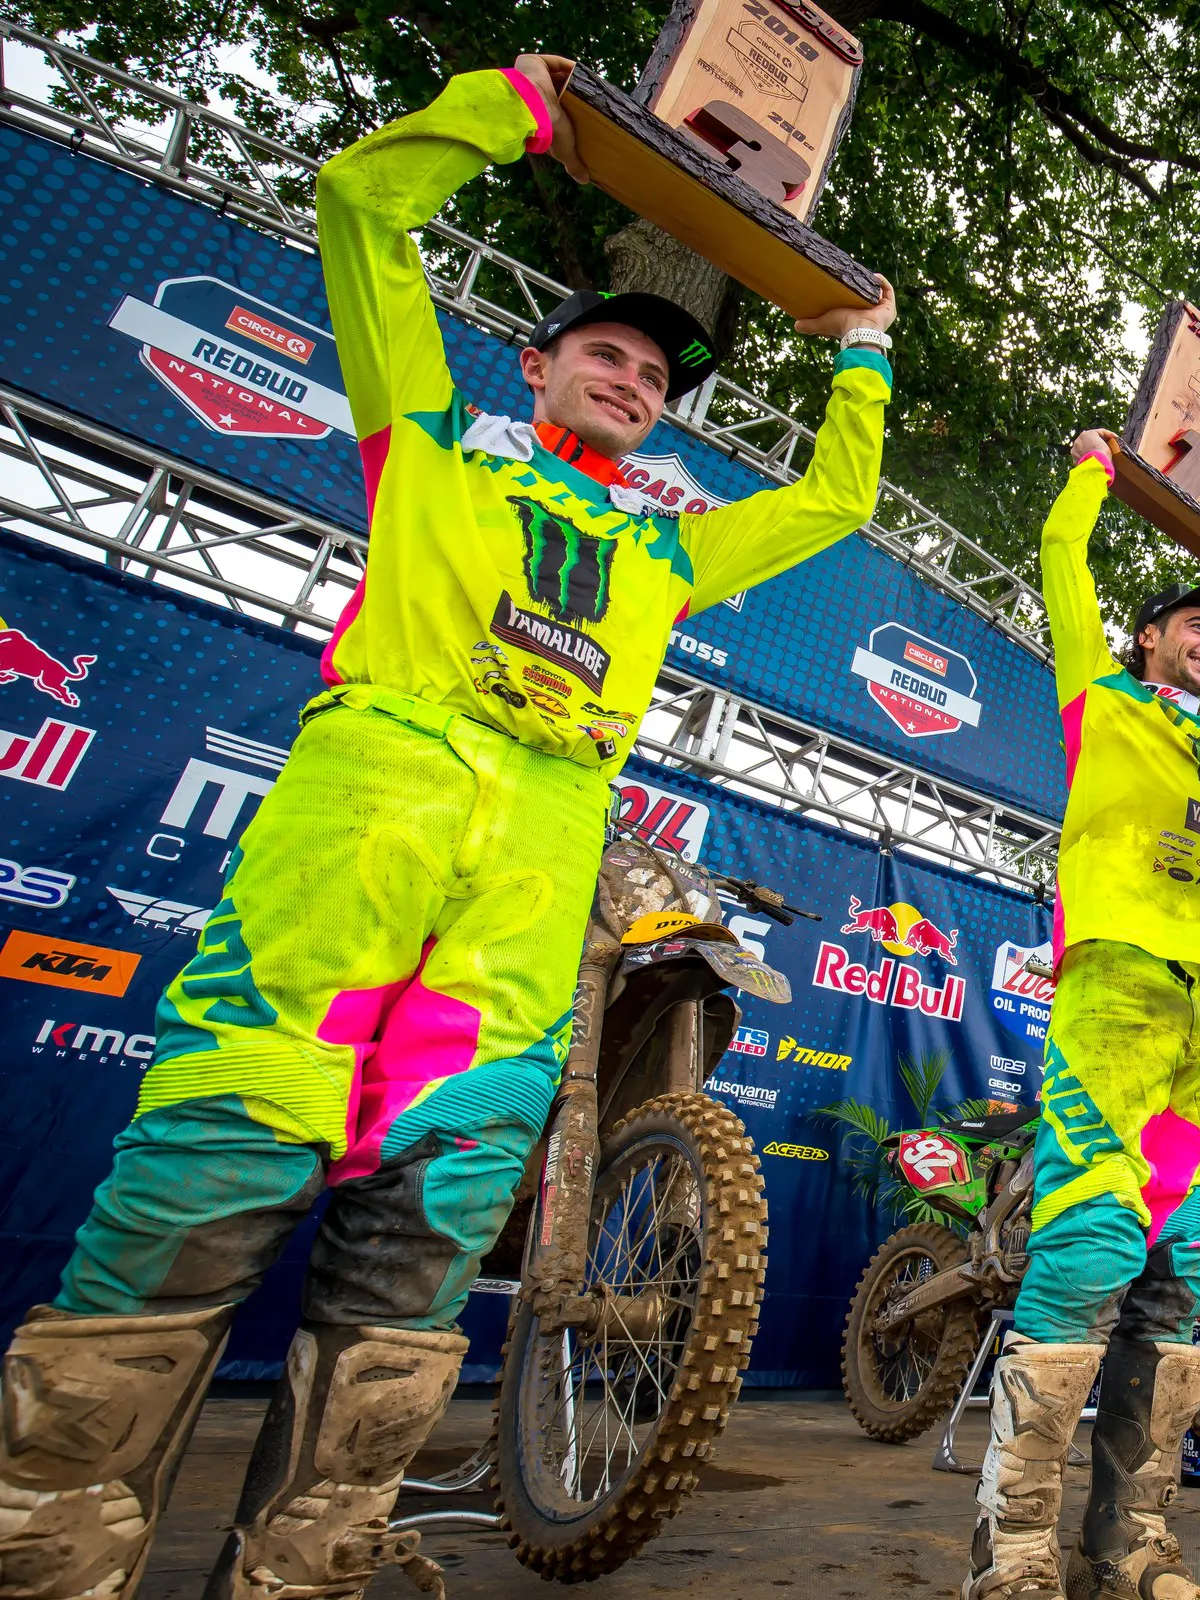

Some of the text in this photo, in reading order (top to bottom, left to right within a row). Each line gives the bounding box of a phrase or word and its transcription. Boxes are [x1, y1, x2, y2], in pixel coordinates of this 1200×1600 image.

[742, 0, 819, 62] 2019
[756, 37, 781, 60] CIRCLE
[697, 58, 744, 98] MOTOCROSS
[742, 57, 787, 93] NATIONAL
[749, 50, 788, 84] REDBUD
[237, 316, 306, 353] CIRCLE K
[191, 338, 308, 403] REDBUD
[168, 359, 308, 428] NATIONAL
[507, 599, 606, 679] YAMALUBE
[541, 668, 566, 683] TOYOTA
[908, 648, 944, 671] CIRCLE K
[522, 666, 573, 697] ESCONDIDO
[890, 668, 948, 707] REDBUD
[879, 688, 950, 725] NATIONAL
[679, 865, 693, 879] OIL
[21, 950, 114, 983] KTM
[813, 940, 967, 1022] Red Bull
[993, 996, 1016, 1013] OIL
[32, 1046, 148, 1071] WHEELS
[793, 1047, 853, 1071] THOR
[990, 1055, 1026, 1075] WPS
[703, 1076, 777, 1101] Husqvarna
[988, 1078, 1021, 1093] GEICO
[738, 1099, 775, 1109] MOTORCYCLES
[543, 1130, 562, 1184] YAMALUBE
